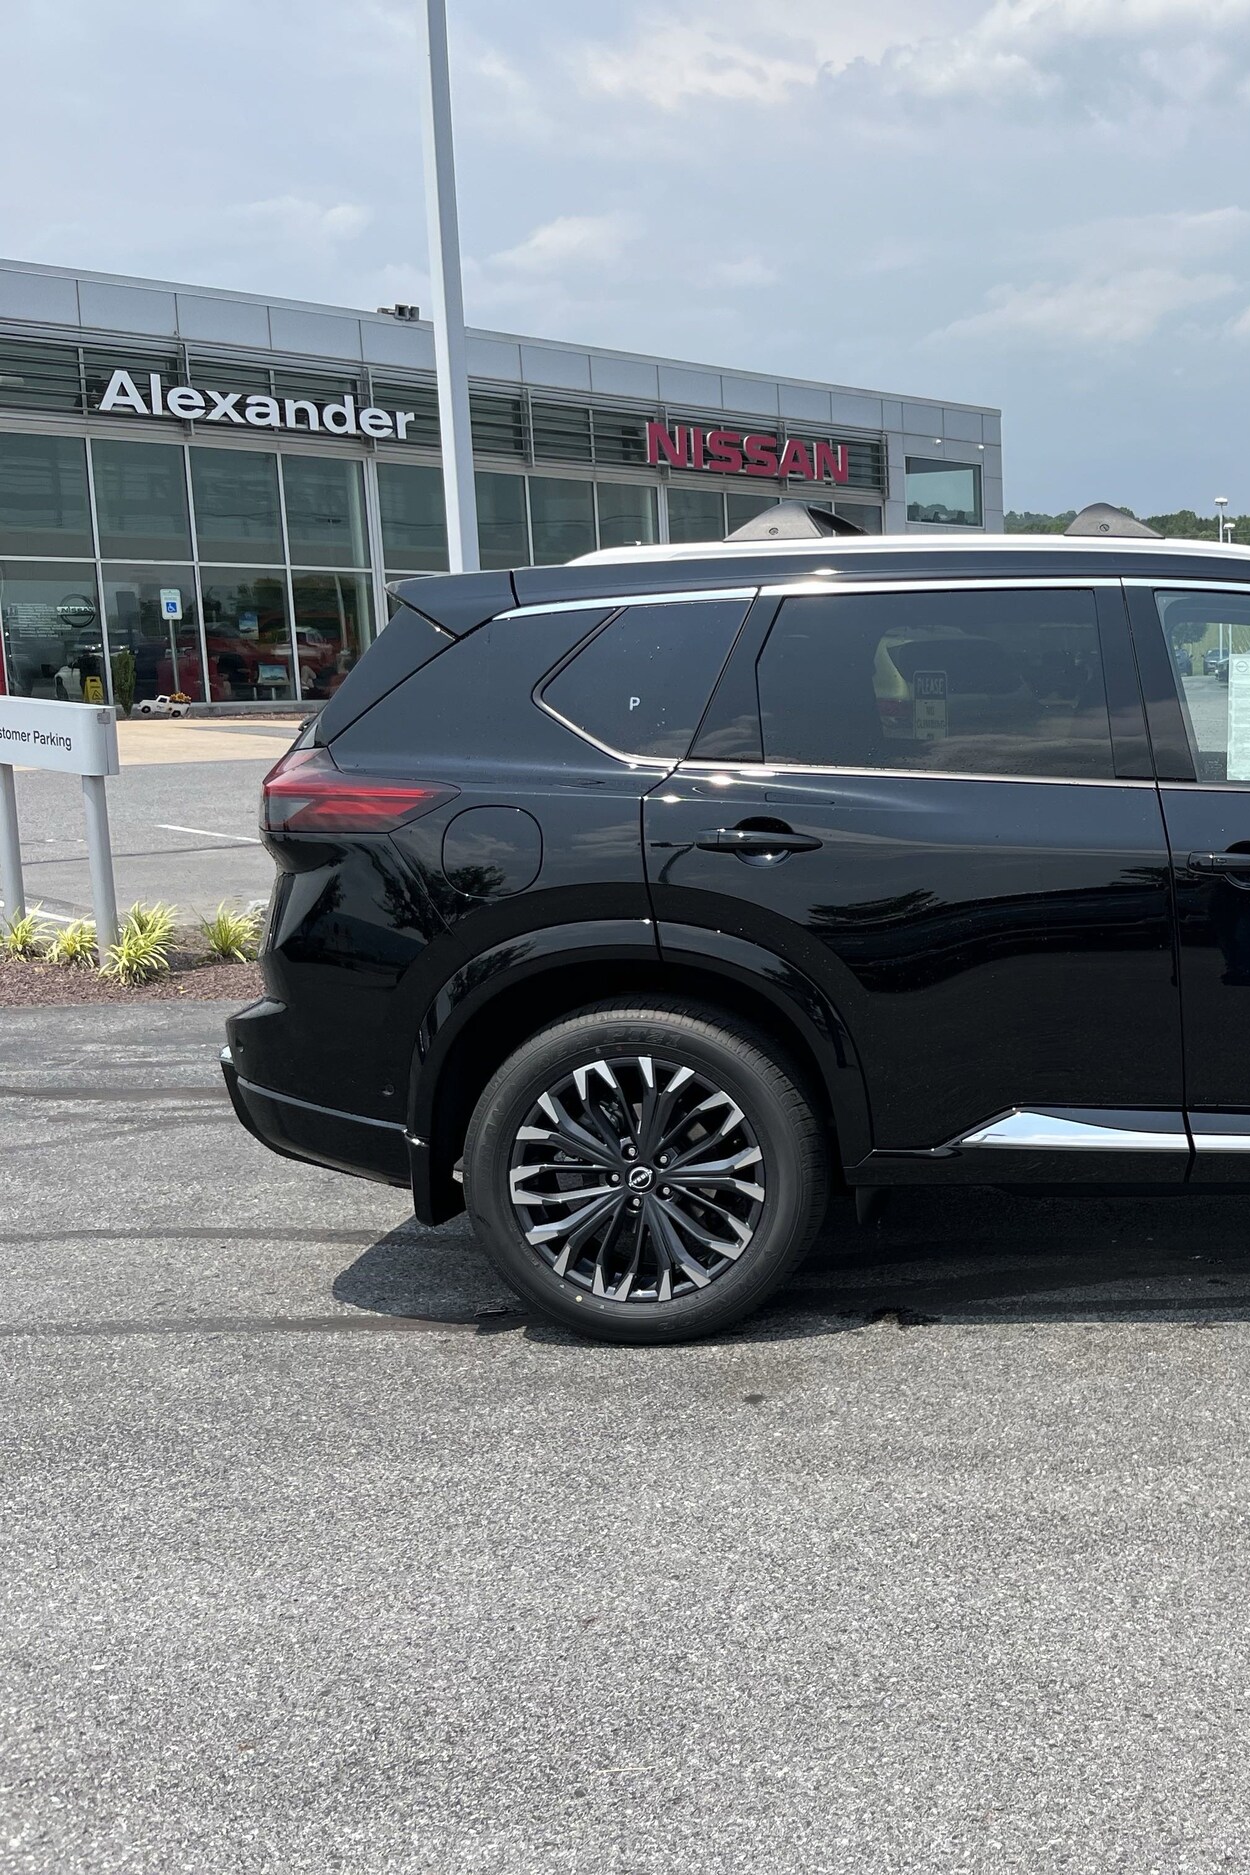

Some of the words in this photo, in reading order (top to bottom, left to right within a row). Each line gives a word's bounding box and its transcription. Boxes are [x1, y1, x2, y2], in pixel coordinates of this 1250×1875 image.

[98, 370, 415, 440] Alexander
[646, 422, 849, 484] NISSAN
[58, 605, 95, 614] NISSAN
[917, 678, 944, 694] PLEASE
[629, 696, 641, 711] P
[33, 730, 72, 751] Parking
